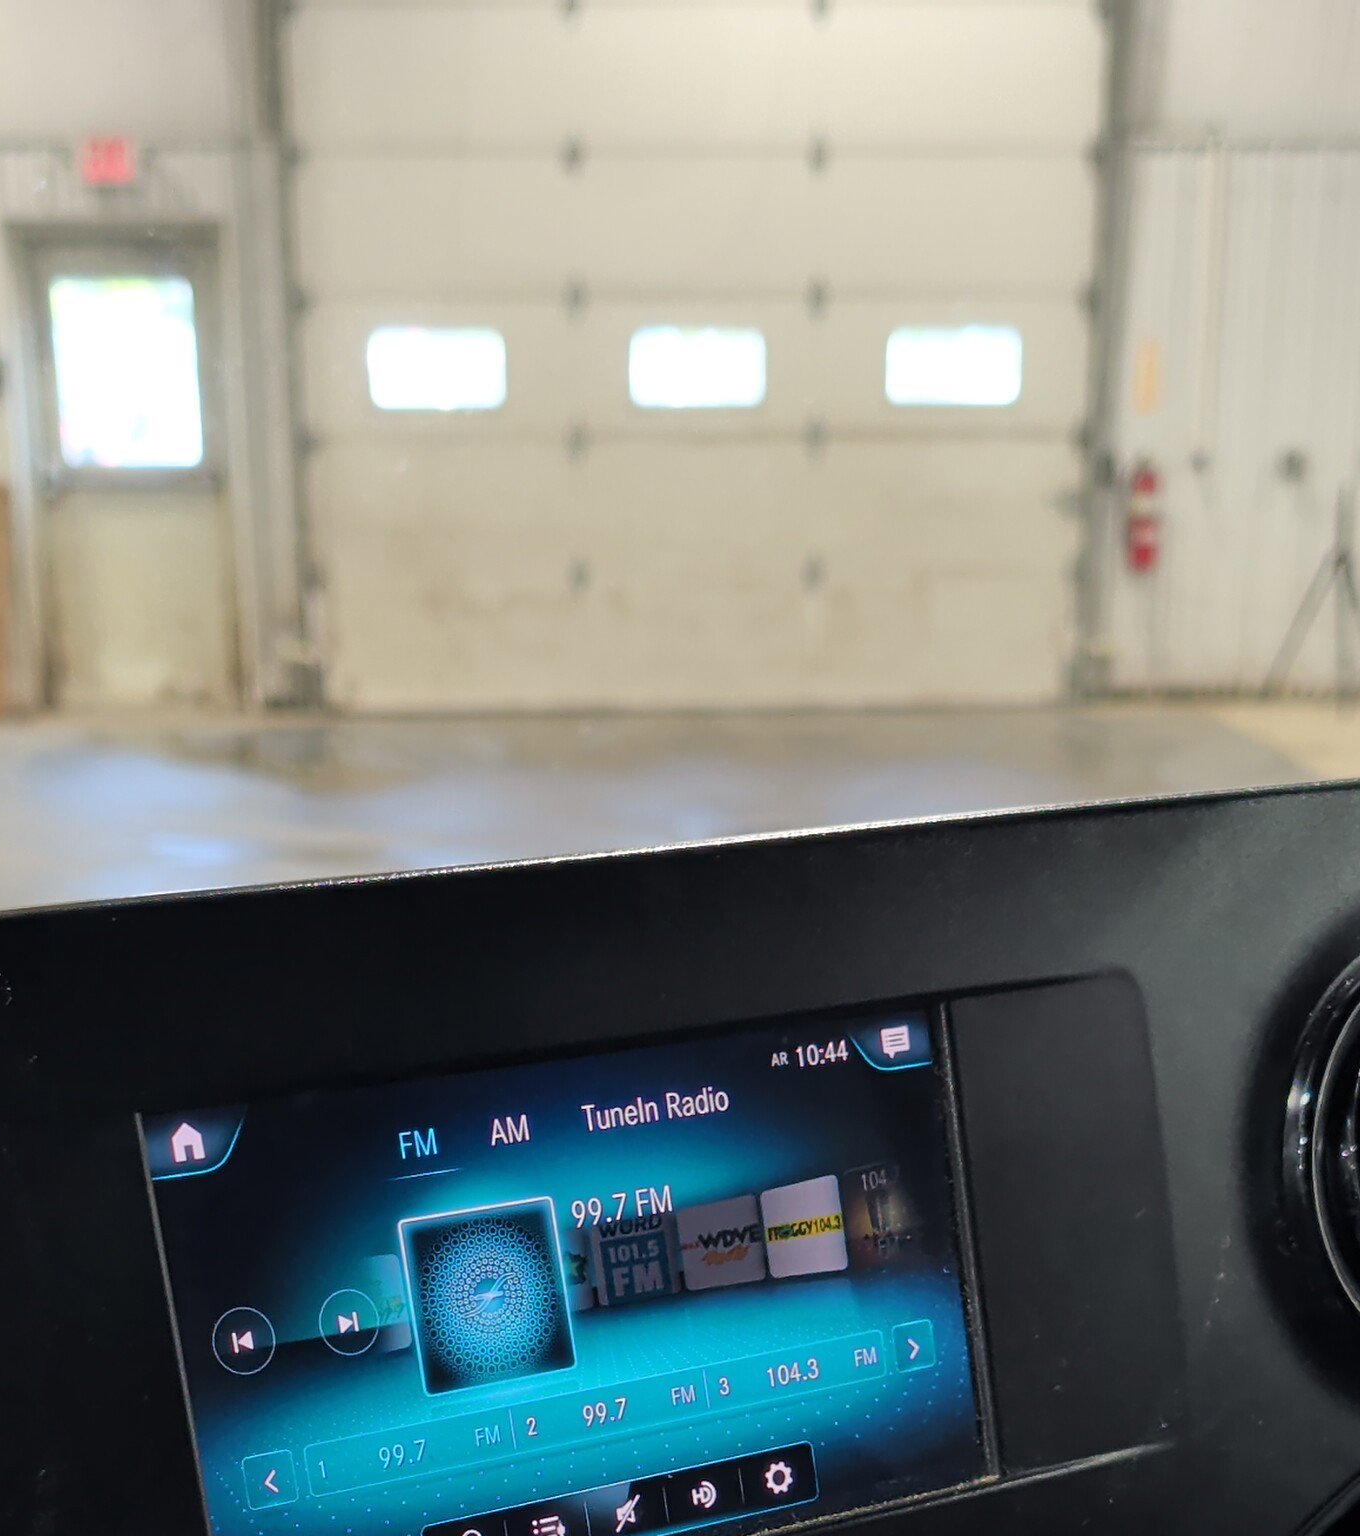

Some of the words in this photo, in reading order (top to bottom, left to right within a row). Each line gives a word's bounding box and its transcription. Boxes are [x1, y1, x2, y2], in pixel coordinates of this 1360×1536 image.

[771, 1052, 789, 1068] AR
[794, 1039, 849, 1069] 10:44
[581, 1096, 659, 1133] TuneIn
[664, 1085, 730, 1119] Radio
[398, 1128, 438, 1160] FM
[490, 1114, 530, 1146] AM
[571, 1191, 627, 1229] 99.7
[634, 1184, 673, 1217] FM
[607, 1239, 660, 1264] 101.5
[698, 1222, 762, 1250] WDVE
[612, 1260, 665, 1297] FM
[765, 1359, 821, 1390] 104.3
[853, 1347, 878, 1369] FM
[718, 1375, 731, 1397] 3
[582, 1398, 628, 1428] 99.7
[671, 1385, 696, 1407] FM
[526, 1416, 539, 1437] 2
[378, 1439, 427, 1471] 99.7
[474, 1426, 502, 1448] FM
[318, 1459, 328, 1480] 1
